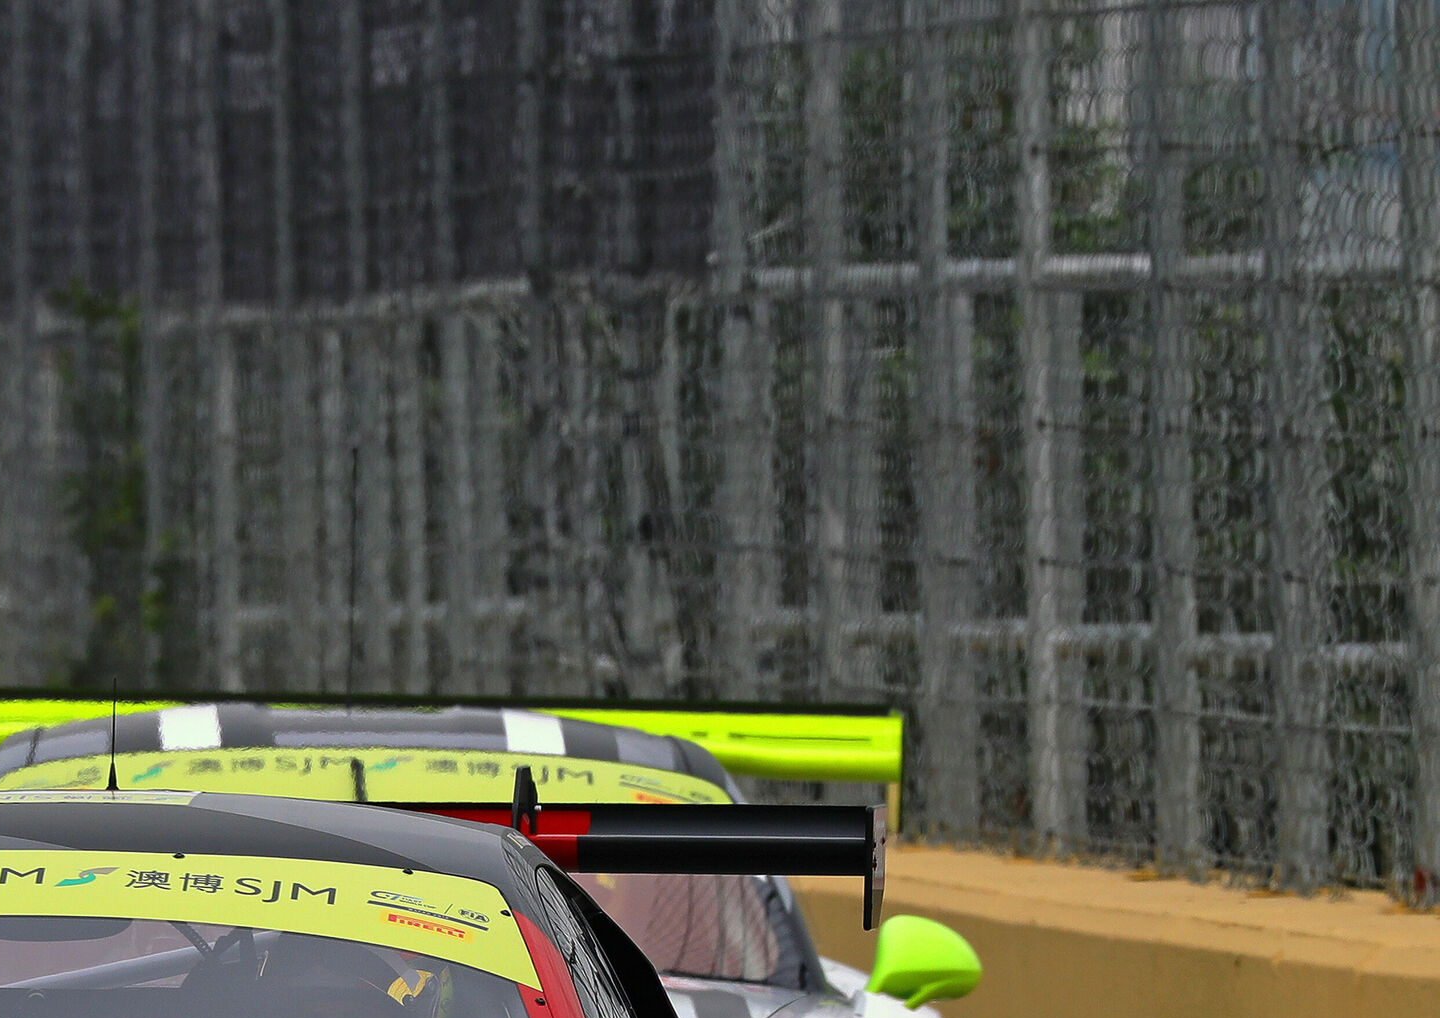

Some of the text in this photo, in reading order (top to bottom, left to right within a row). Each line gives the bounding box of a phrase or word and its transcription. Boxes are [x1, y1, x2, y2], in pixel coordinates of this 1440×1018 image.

[125, 869, 337, 905] 澳博 SJM
[387, 913, 466, 939] PIRELLI
[458, 909, 489, 923] FIA
